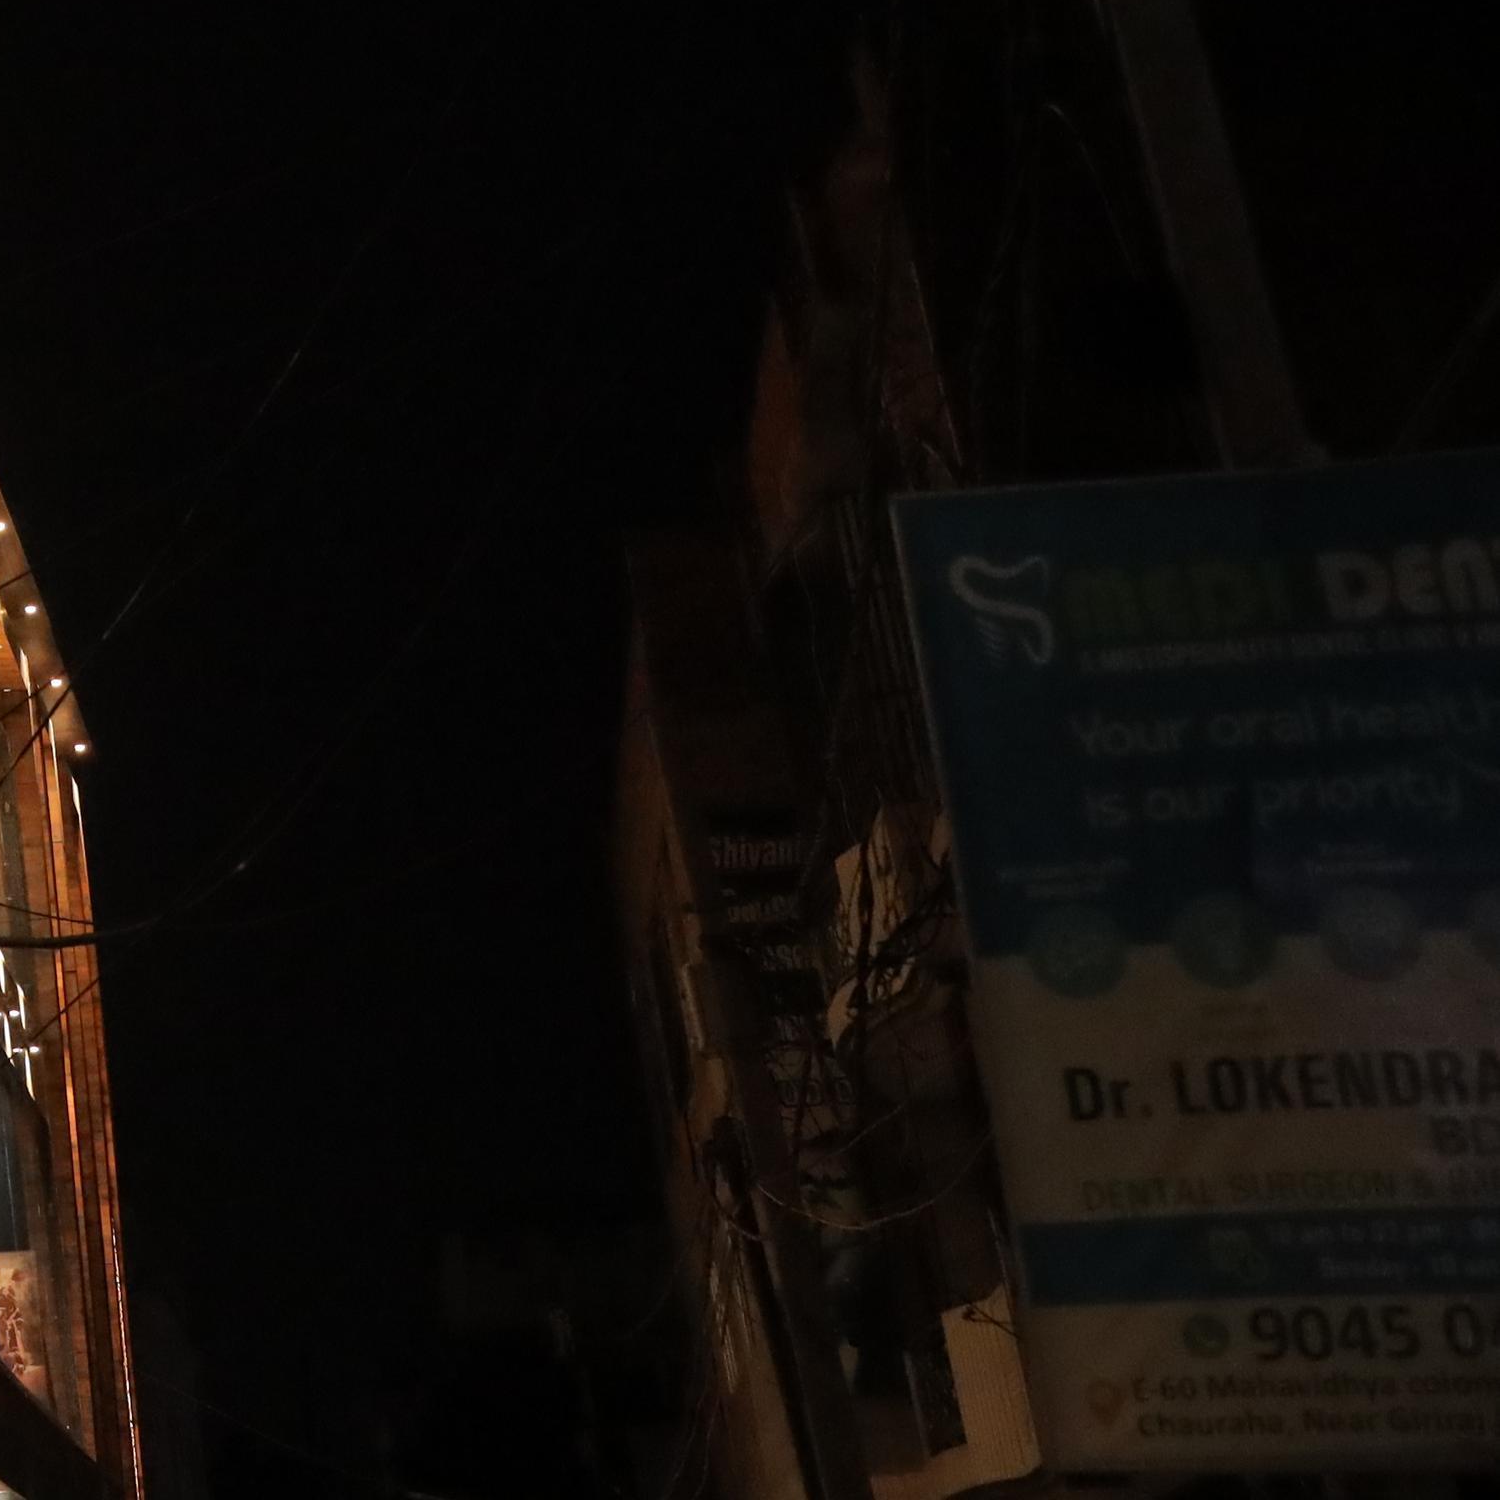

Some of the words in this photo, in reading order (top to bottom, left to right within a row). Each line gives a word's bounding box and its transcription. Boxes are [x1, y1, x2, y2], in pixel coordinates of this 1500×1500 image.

[1067, 710, 1193, 758] Your
[1208, 697, 1317, 747] oral
[1142, 783, 1240, 821] our
[1253, 763, 1463, 831] priority
[1063, 1065, 1155, 1121] Dr.
[1248, 1303, 1422, 1363] 9045
